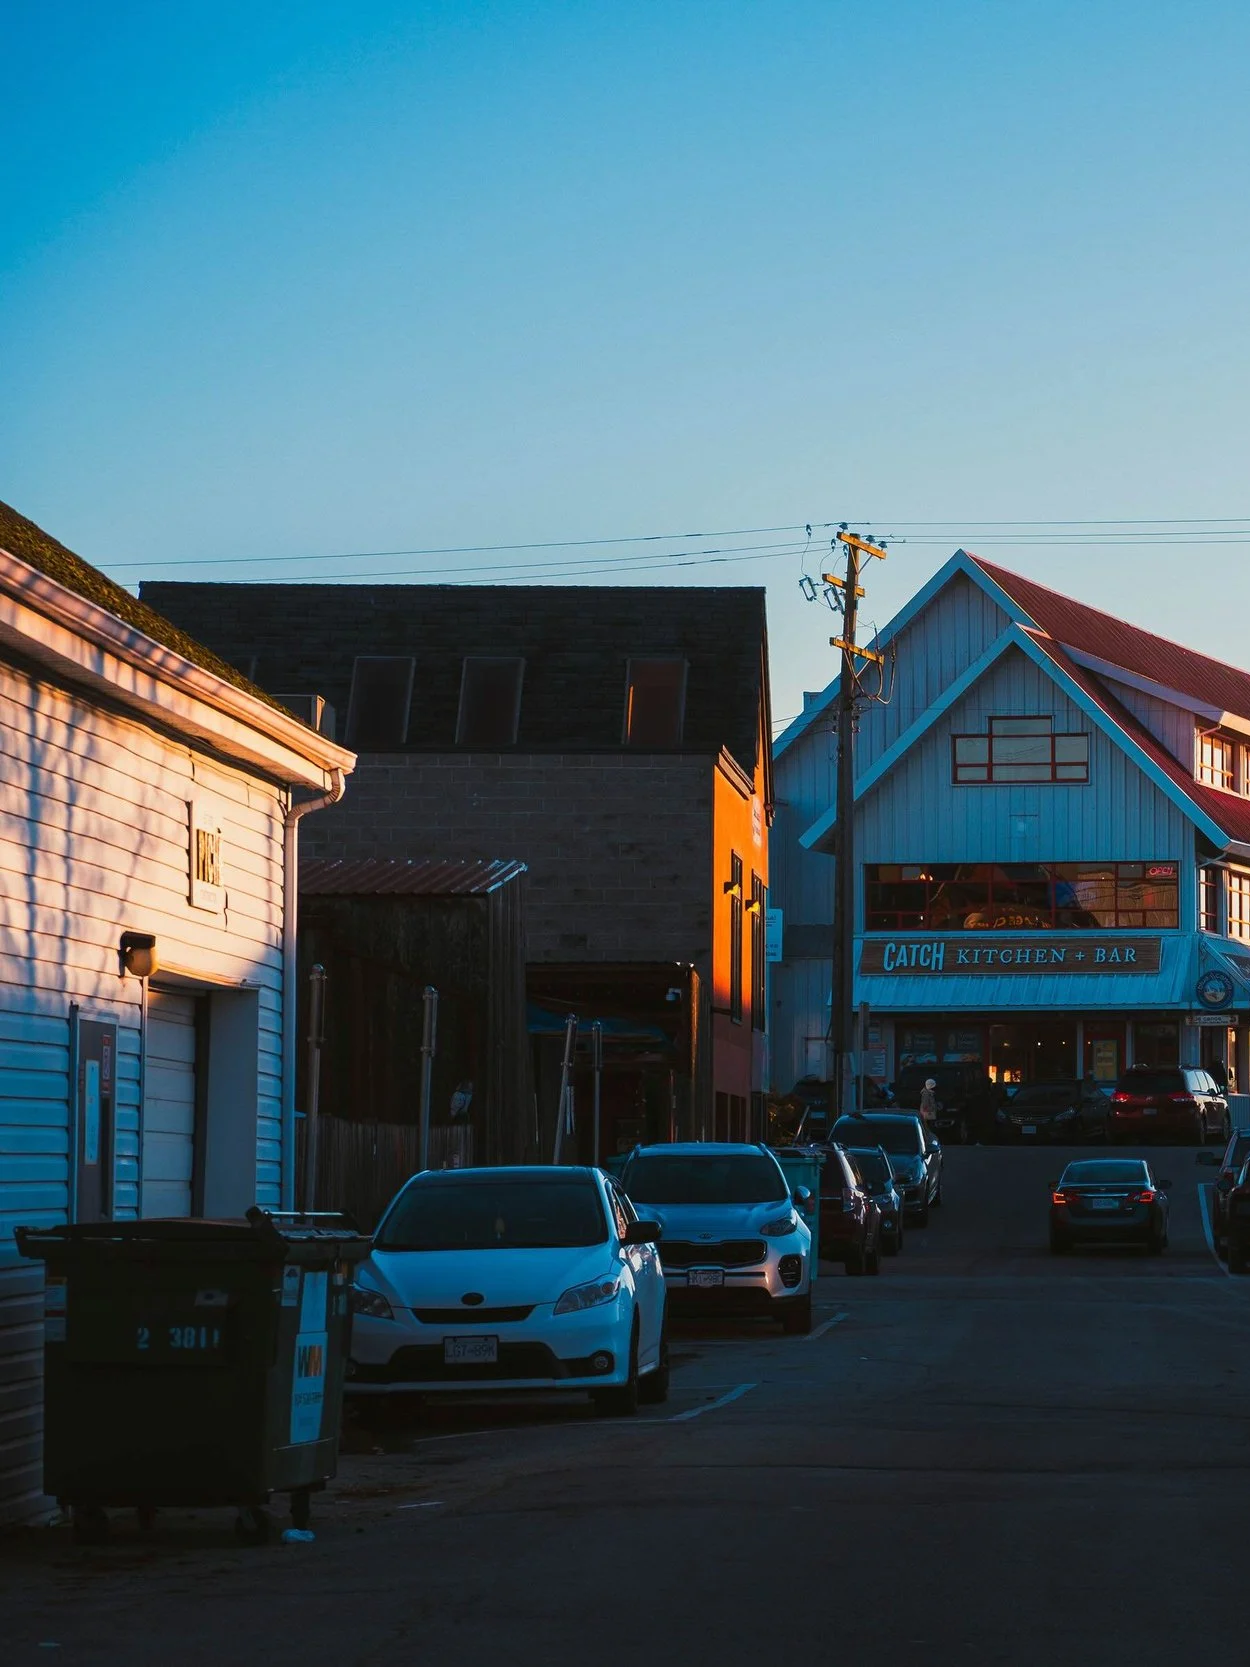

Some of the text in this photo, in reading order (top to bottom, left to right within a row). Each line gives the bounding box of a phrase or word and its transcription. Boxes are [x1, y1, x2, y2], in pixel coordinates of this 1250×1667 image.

[883, 942, 945, 972] CATCH
[956, 948, 1067, 964] KITCHEN
[1095, 948, 1137, 963] BAR
